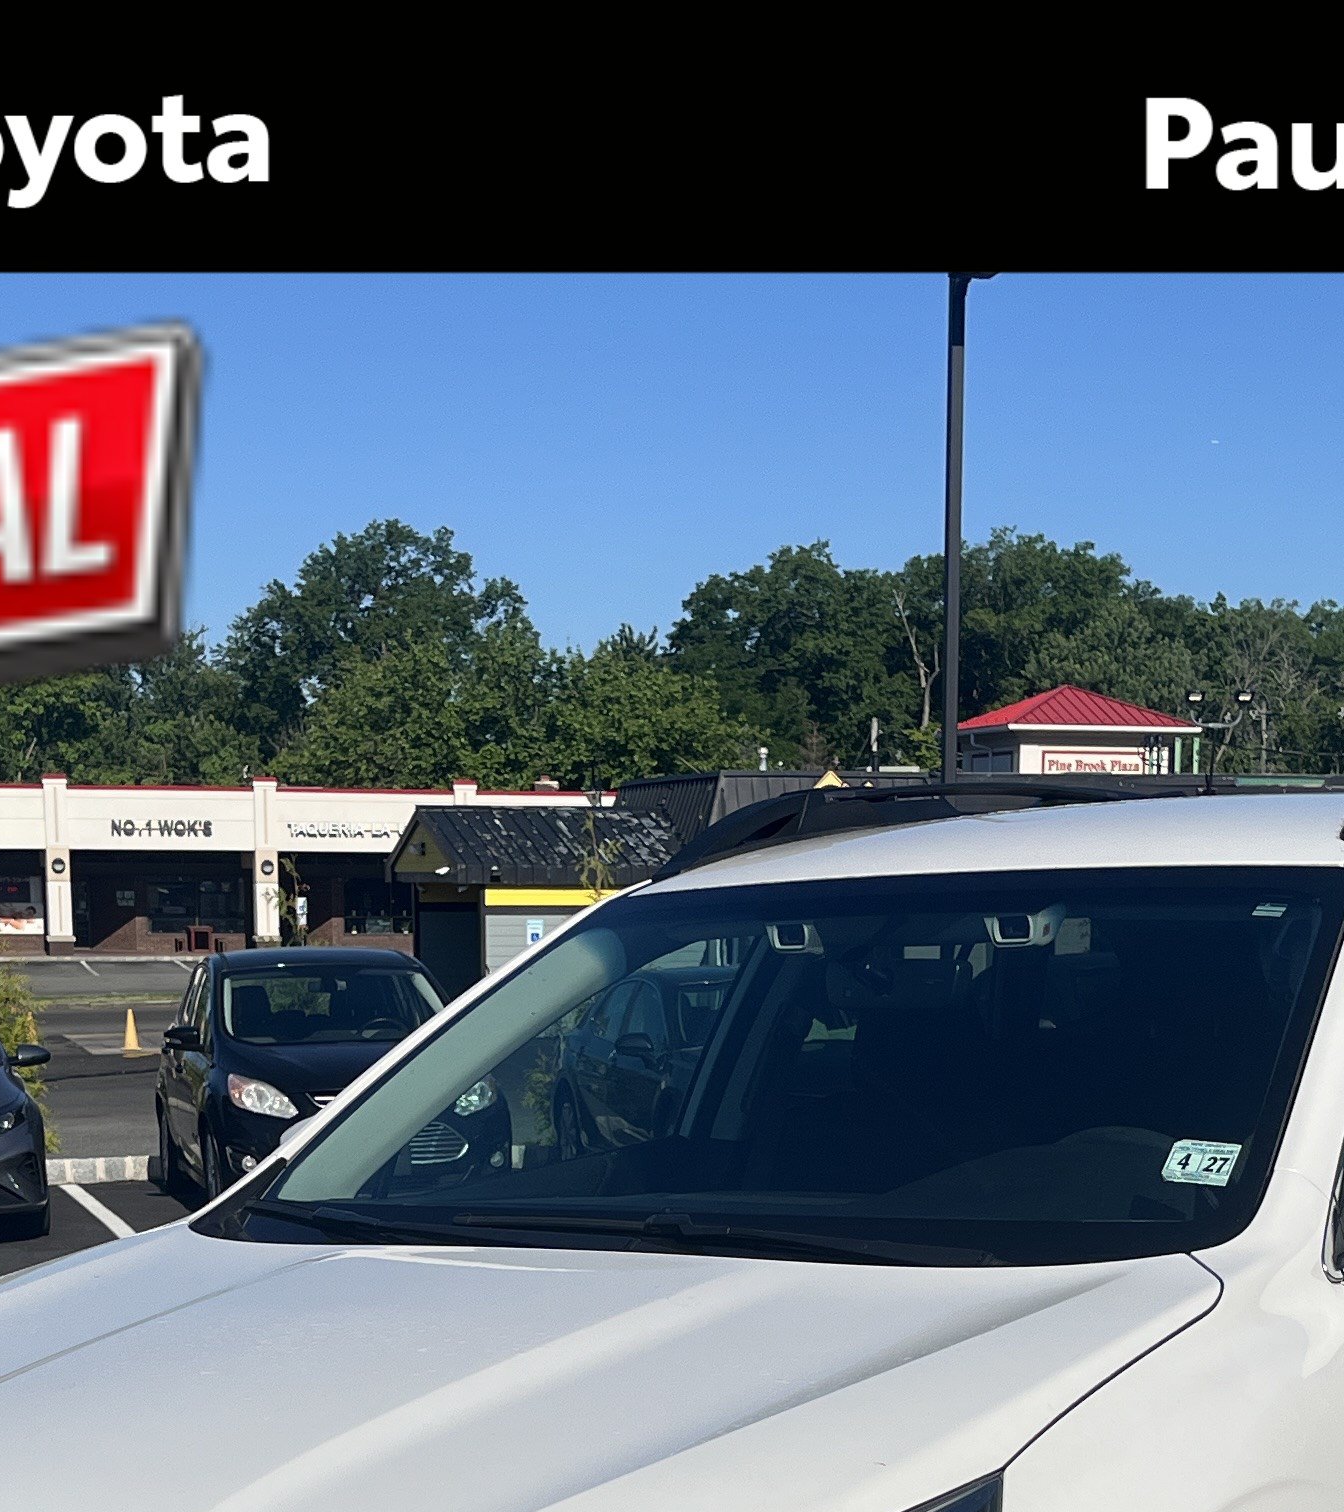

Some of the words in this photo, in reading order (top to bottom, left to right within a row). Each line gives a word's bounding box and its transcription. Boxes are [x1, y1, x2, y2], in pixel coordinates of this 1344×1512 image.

[1047, 759, 1072, 771] Pine
[1075, 759, 1107, 771] Brook
[1110, 759, 1140, 771] Plaza
[157, 819, 213, 838] WOK'S
[286, 822, 365, 838] TAQUERIA
[371, 822, 391, 838] LA
[1176, 1152, 1193, 1170] 4
[1202, 1156, 1231, 1174] 27
